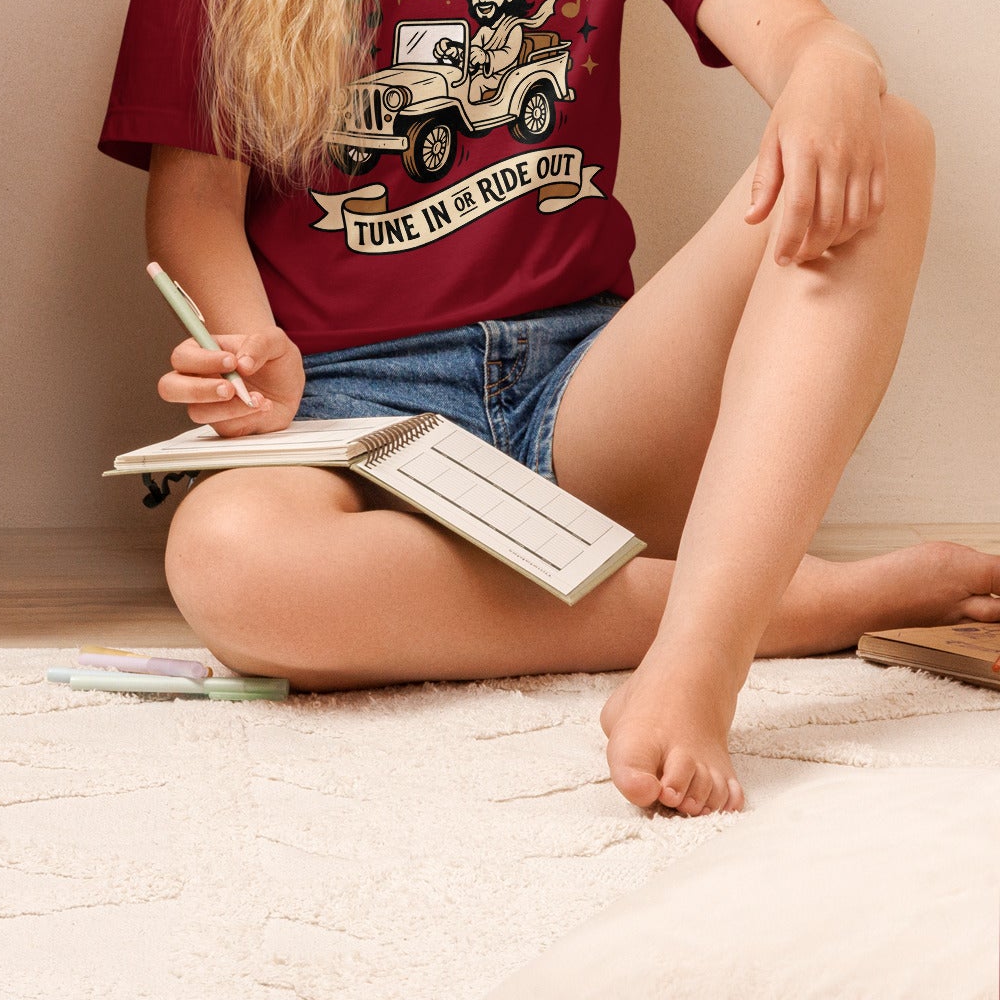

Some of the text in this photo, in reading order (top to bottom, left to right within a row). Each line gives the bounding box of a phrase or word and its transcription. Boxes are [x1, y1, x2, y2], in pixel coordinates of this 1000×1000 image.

[353, 153, 576, 246] TUNE IN OR RIDE OUT
